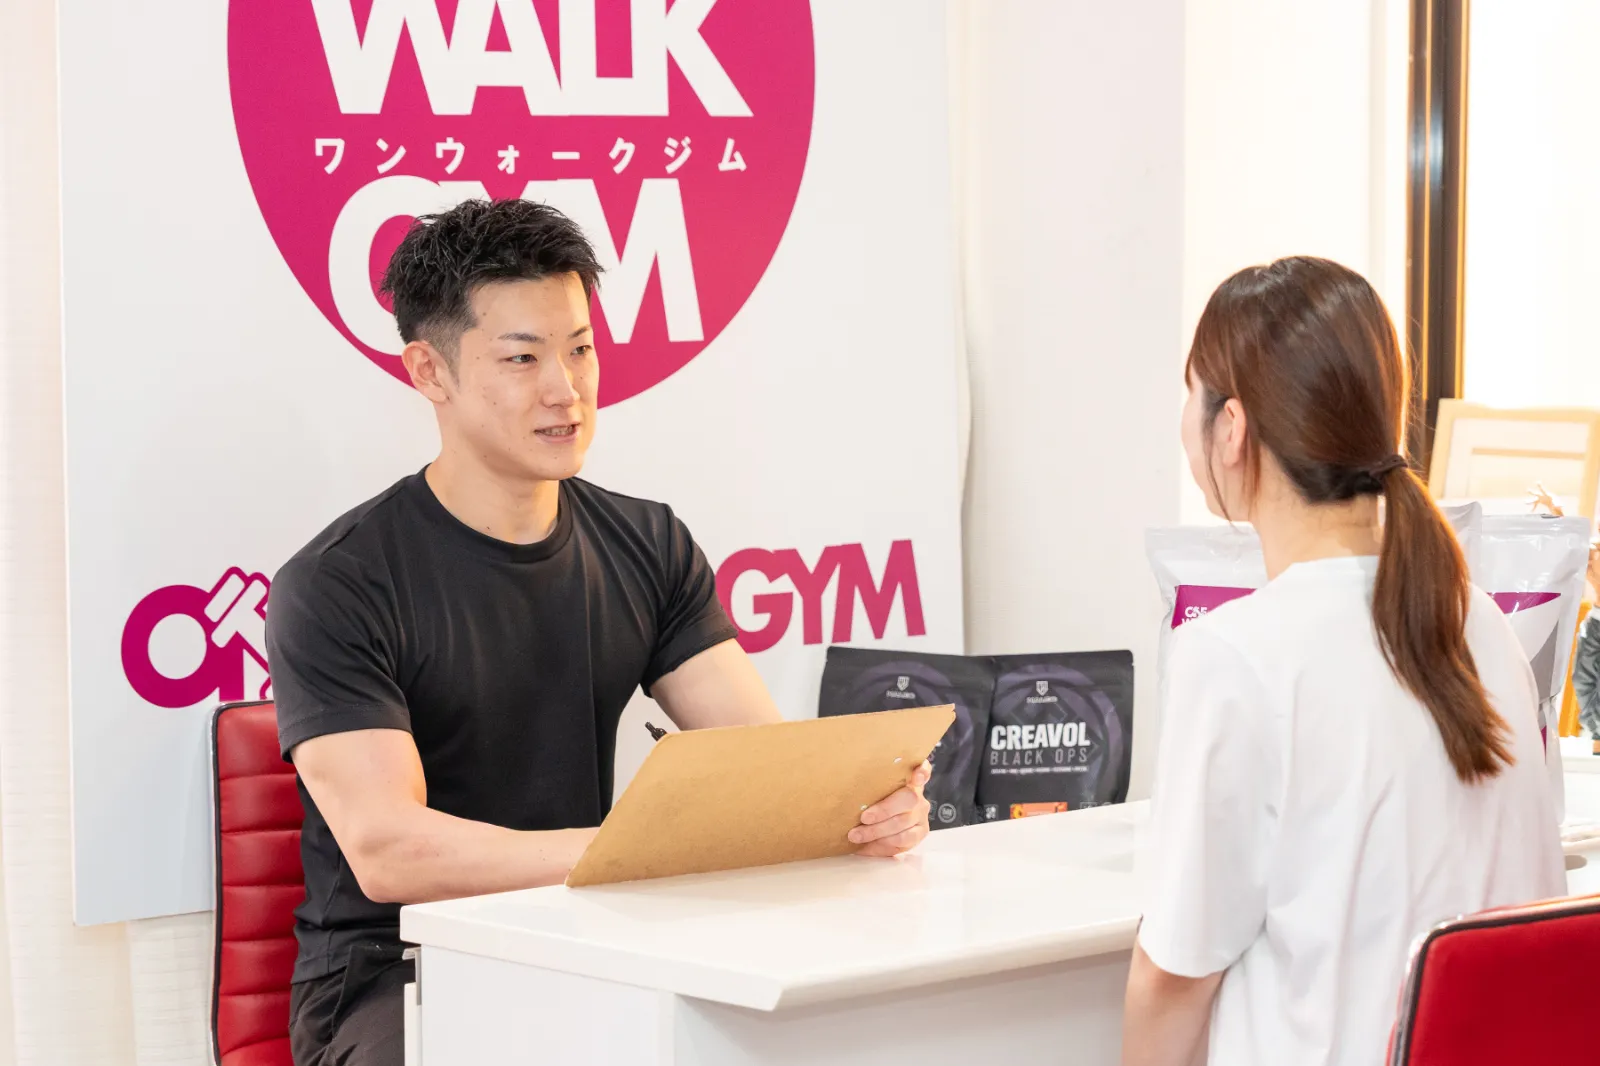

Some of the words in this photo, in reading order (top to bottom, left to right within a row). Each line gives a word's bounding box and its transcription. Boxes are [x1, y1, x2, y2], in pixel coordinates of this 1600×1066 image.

[309, 0, 754, 117] WALK
[314, 137, 747, 174] ワンウォークジム
[715, 539, 926, 653] GYM
[991, 722, 1091, 750] CREAVOL
[990, 750, 1043, 766] BLACK
[1055, 748, 1088, 764] OPS
